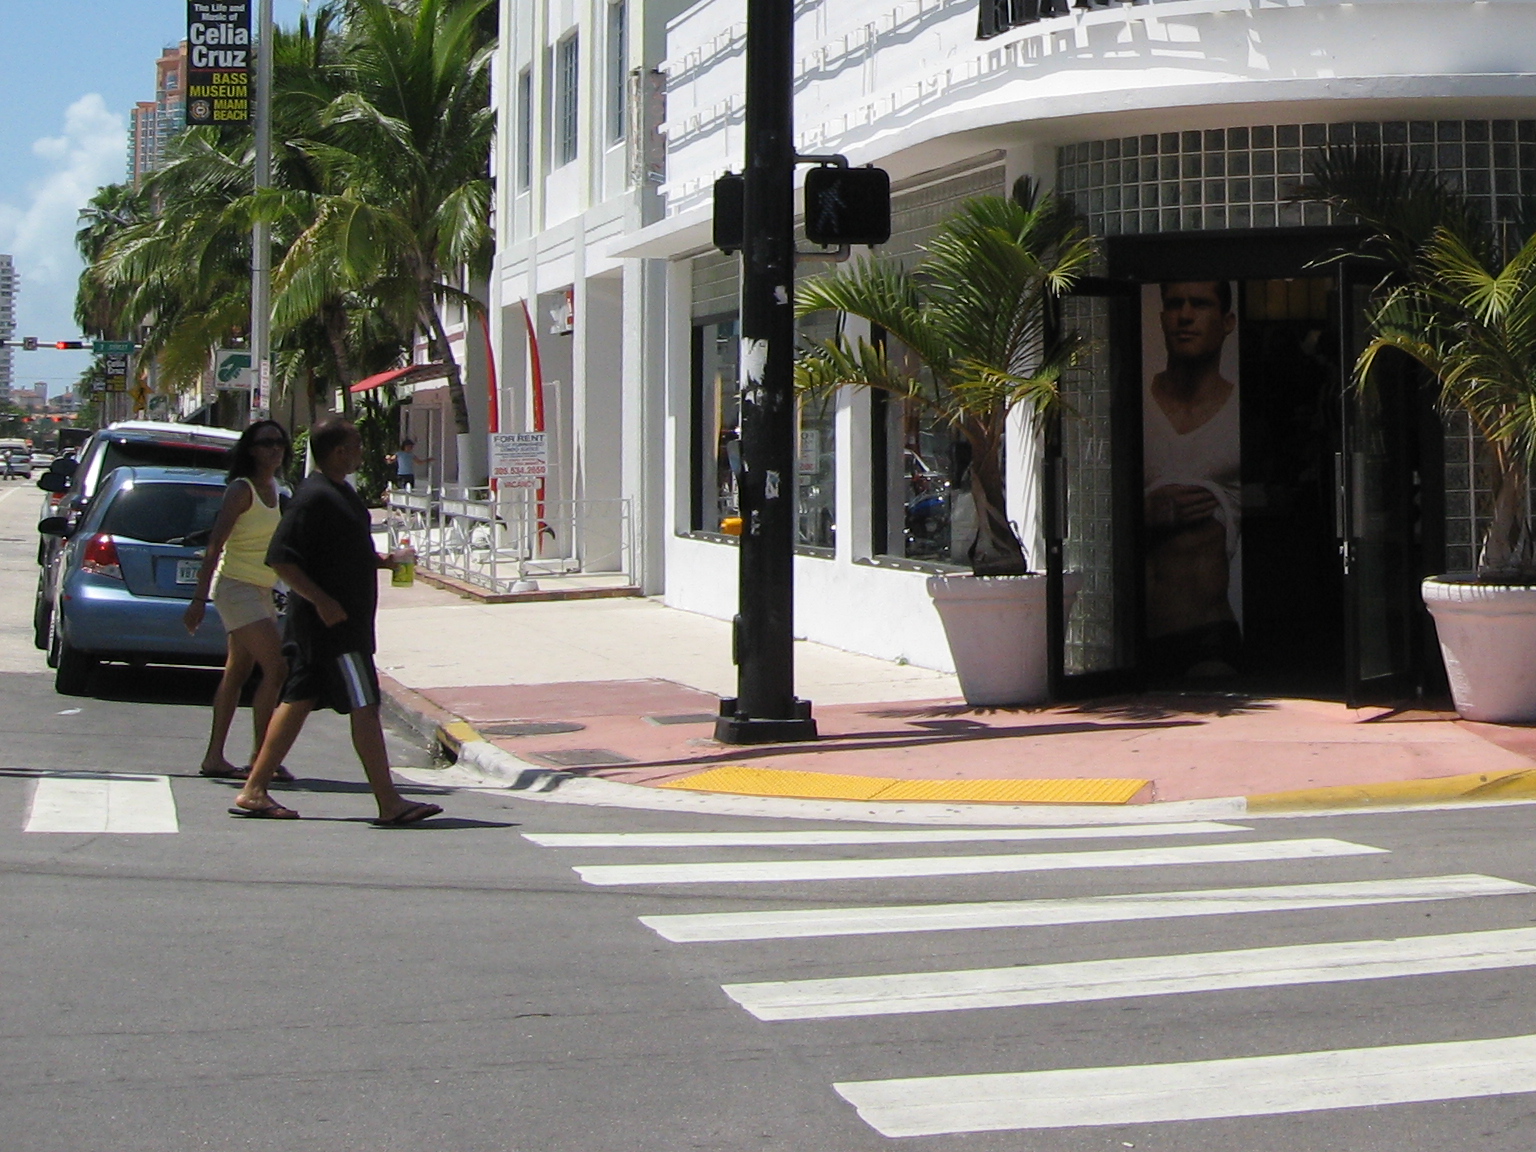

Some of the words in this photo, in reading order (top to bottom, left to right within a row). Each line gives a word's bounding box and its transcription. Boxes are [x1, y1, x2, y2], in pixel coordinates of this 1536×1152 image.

[228, 12, 238, 21] of
[189, 22, 249, 45] Celia
[192, 45, 247, 67] Cruz
[212, 72, 248, 85] BASS
[190, 85, 248, 98] MUSEUM
[213, 99, 248, 110] MIAMI
[213, 109, 248, 121] BEACH
[517, 434, 545, 442] RENT
